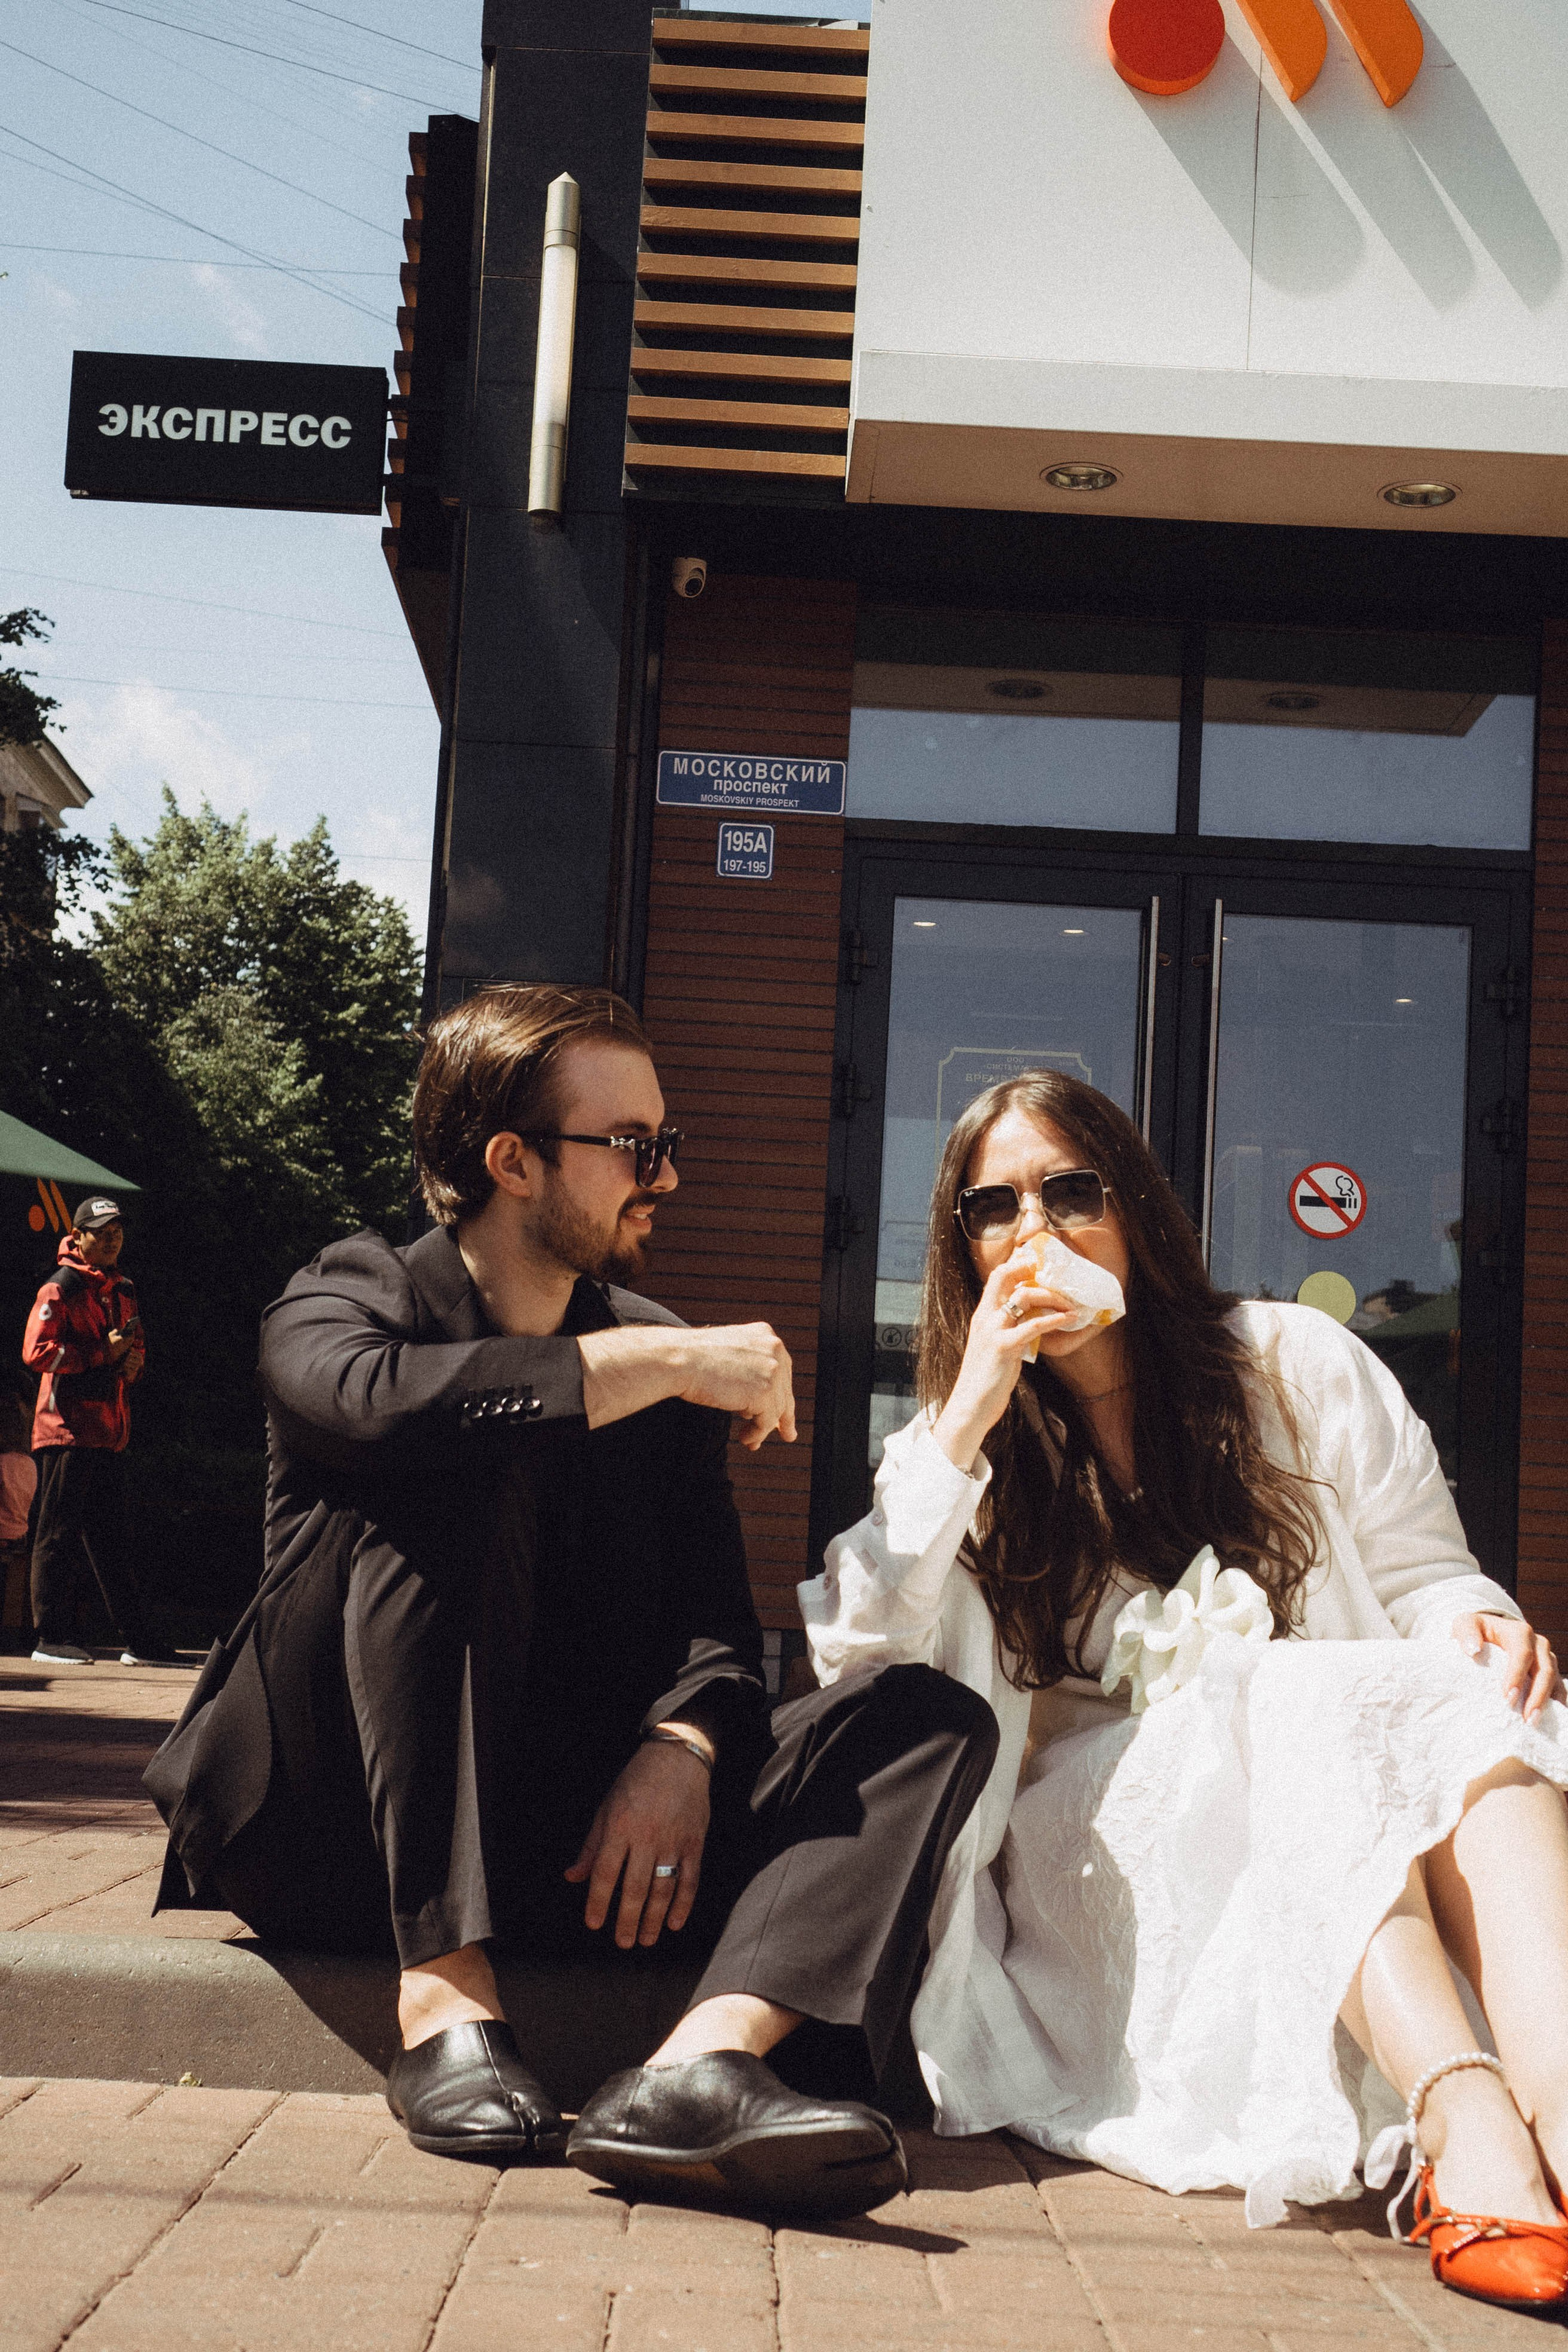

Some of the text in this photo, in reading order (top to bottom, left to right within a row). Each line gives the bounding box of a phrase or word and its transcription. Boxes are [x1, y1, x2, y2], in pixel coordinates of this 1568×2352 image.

[98, 404, 352, 449] ЭКСПРЕСС
[674, 758, 830, 783] МОСКОВСКИЙ
[714, 778, 788, 794] проспект
[701, 794, 799, 807] MOSKOVSKIY PROSPEKT
[725, 831, 767, 853] 195А
[723, 859, 766, 874] 197-195
